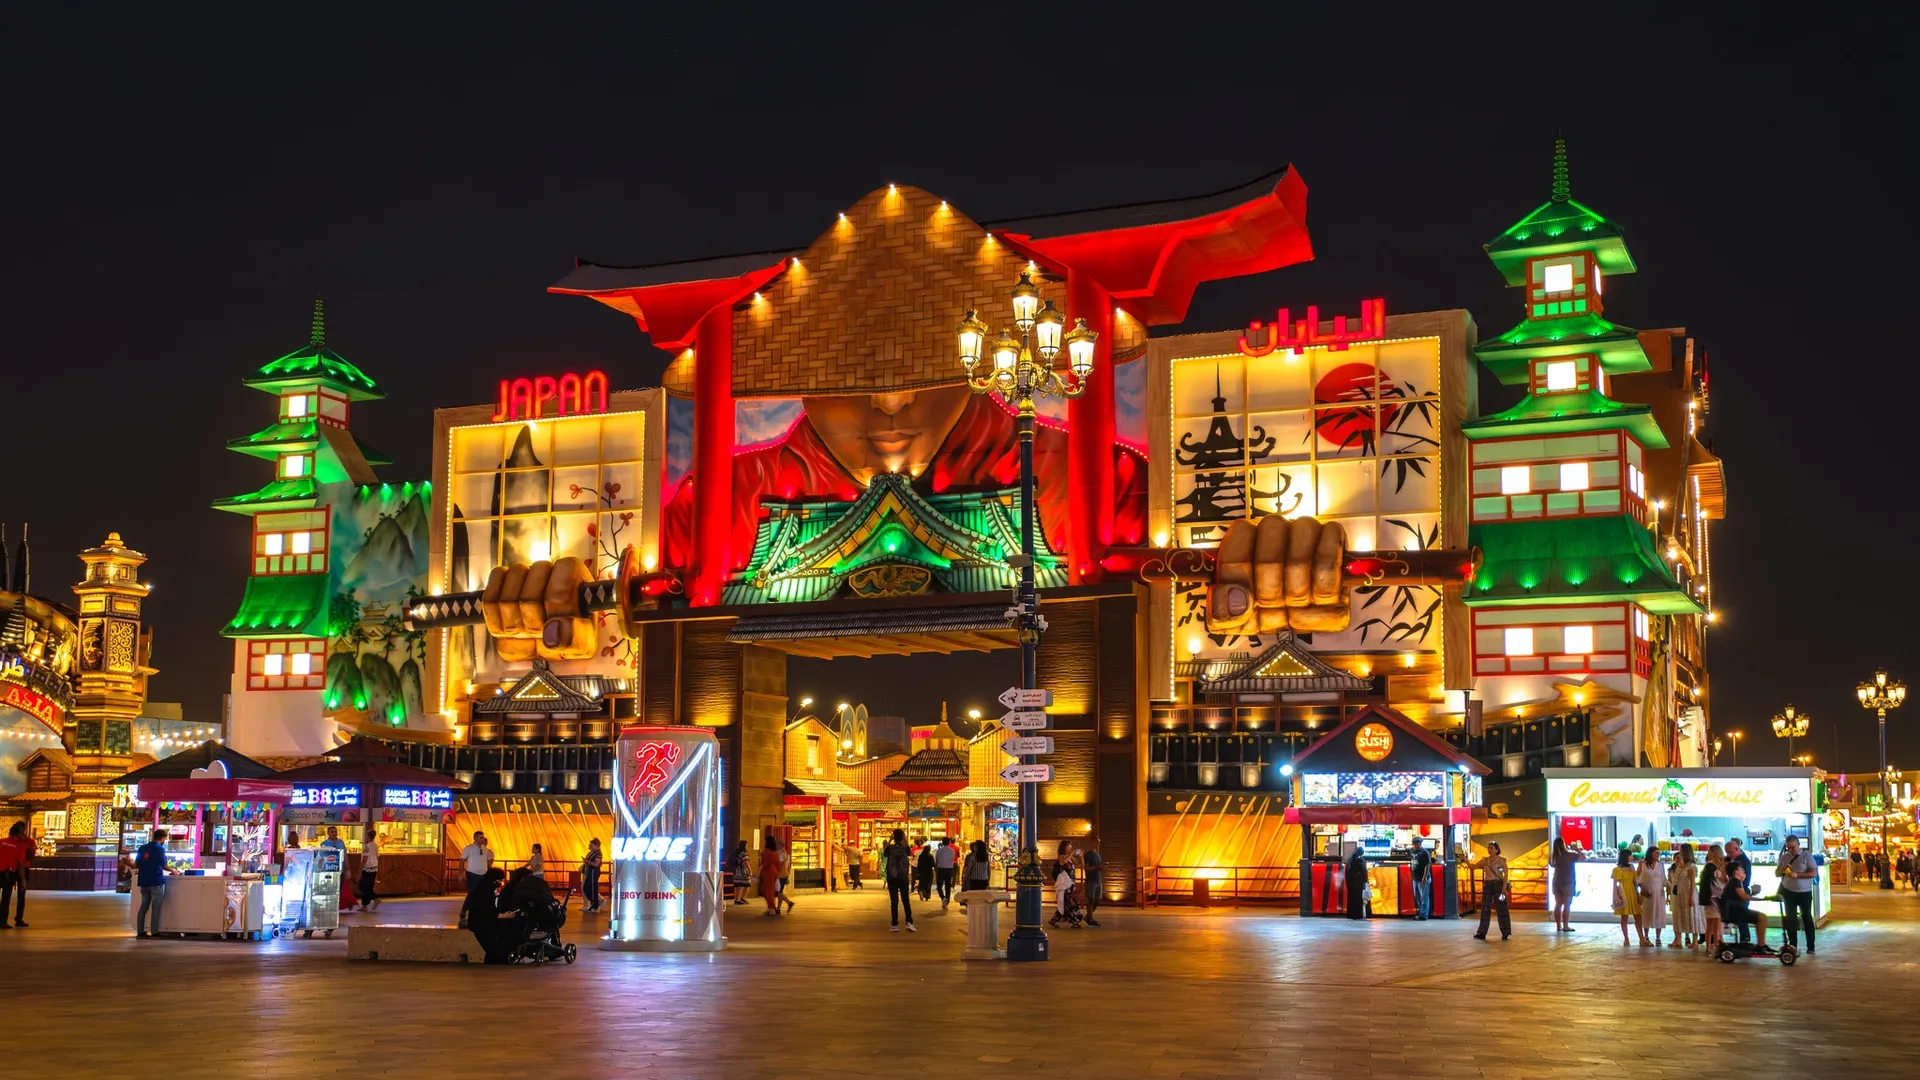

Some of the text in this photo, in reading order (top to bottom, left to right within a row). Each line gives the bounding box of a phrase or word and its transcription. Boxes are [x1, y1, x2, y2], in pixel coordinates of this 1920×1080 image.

[1237, 298, 1385, 358] اليابان
[490, 369, 608, 423] JAPAN
[7, 687, 53, 721] ASIA
[1359, 737, 1390, 747] SUSHI
[307, 788, 333, 804] BR
[411, 790, 431, 806] BR
[1569, 781, 1763, 807] Coconut House
[289, 807, 336, 819] Scoop the Joy
[401, 810, 439, 821] Scoop the Joy
[644, 892, 677, 900] DRINK
